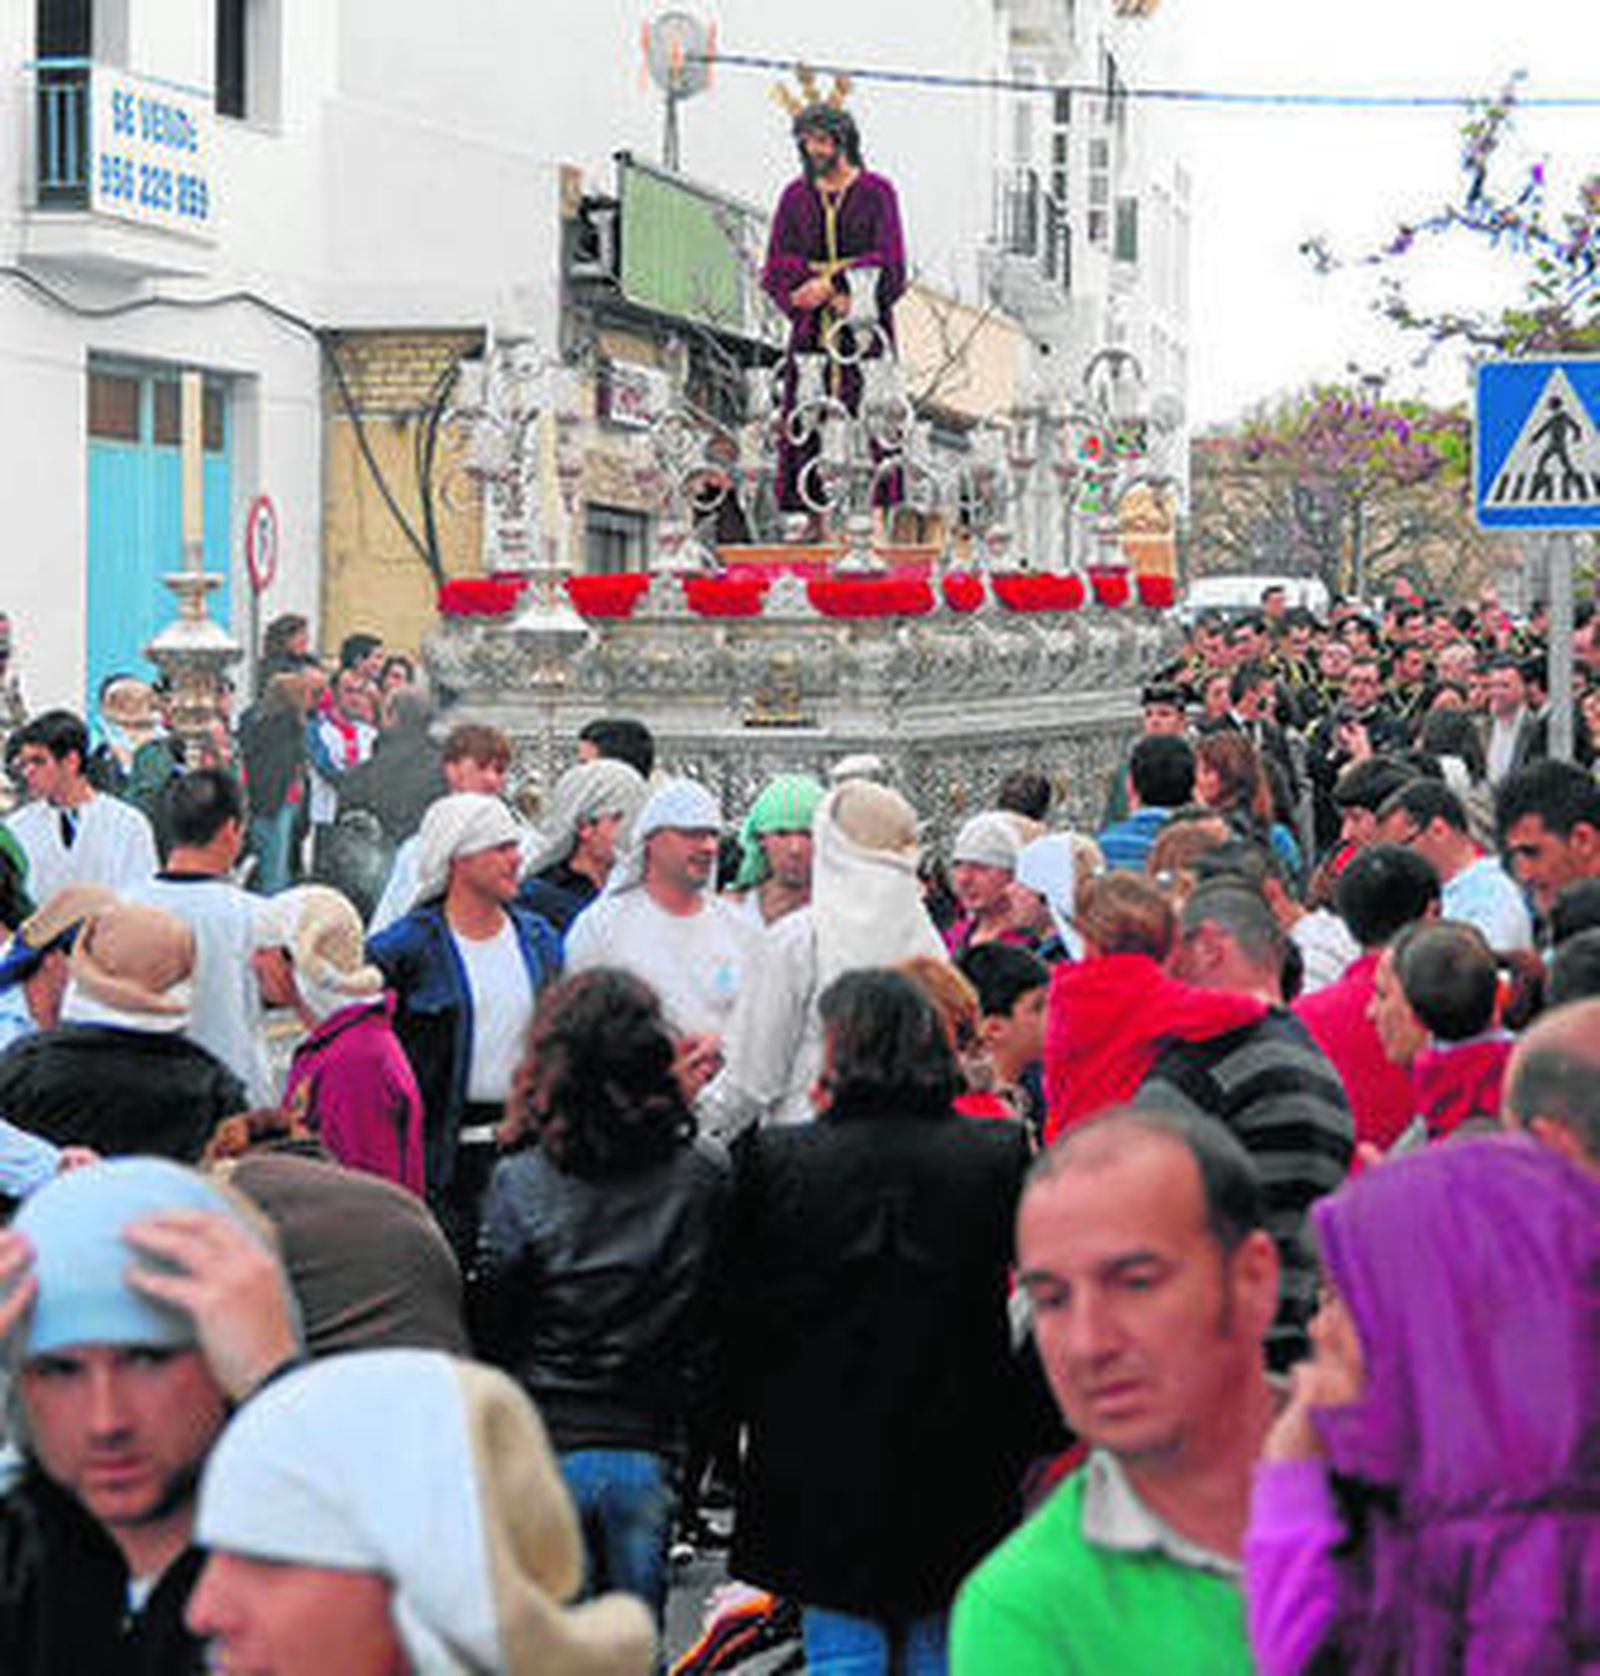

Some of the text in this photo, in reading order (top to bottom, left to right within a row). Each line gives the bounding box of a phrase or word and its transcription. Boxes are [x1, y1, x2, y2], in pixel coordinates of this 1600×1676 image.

[112, 88, 198, 153] SE VENDE
[101, 153, 134, 199] 956
